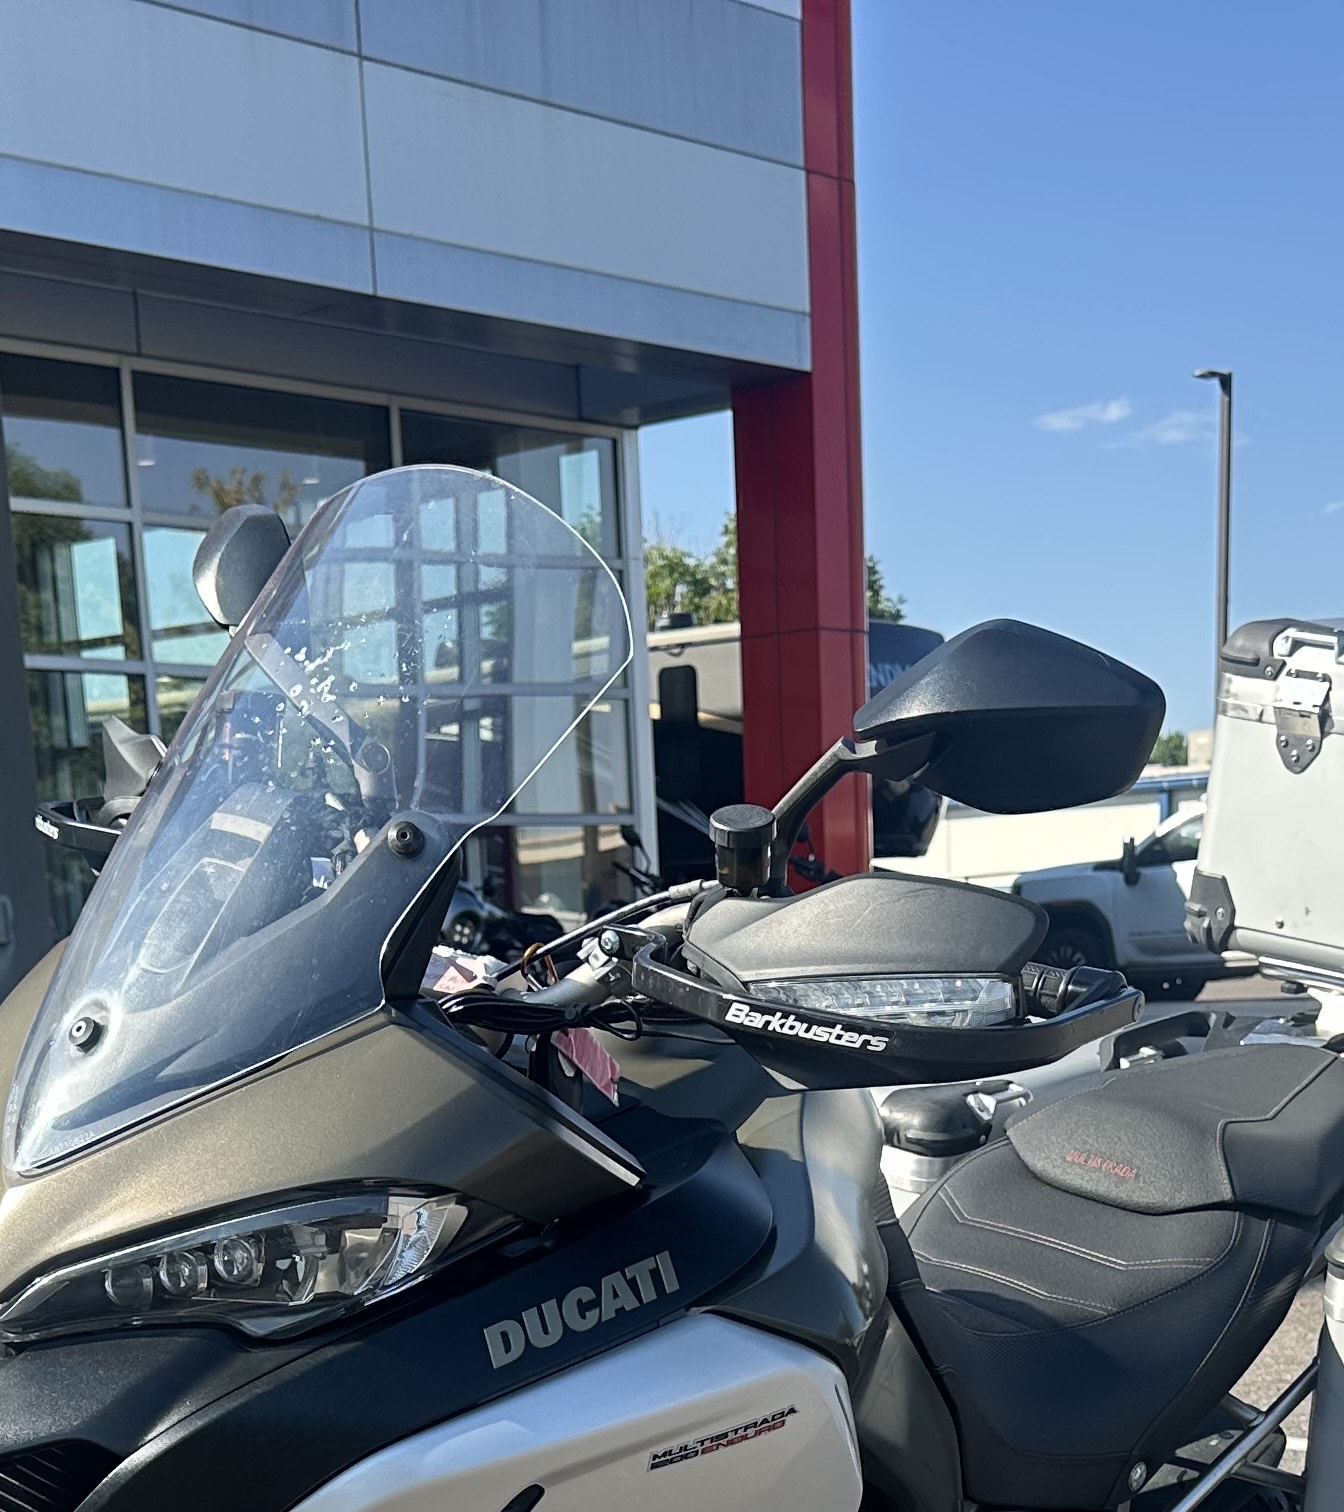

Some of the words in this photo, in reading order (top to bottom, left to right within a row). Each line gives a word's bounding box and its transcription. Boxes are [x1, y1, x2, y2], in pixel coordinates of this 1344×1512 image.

[725, 1001, 890, 1052] Barkbusters
[483, 1250, 680, 1369] DUCATI
[651, 1404, 799, 1462] MULTISTRADA
[700, 1418, 787, 1457] ENDURO
